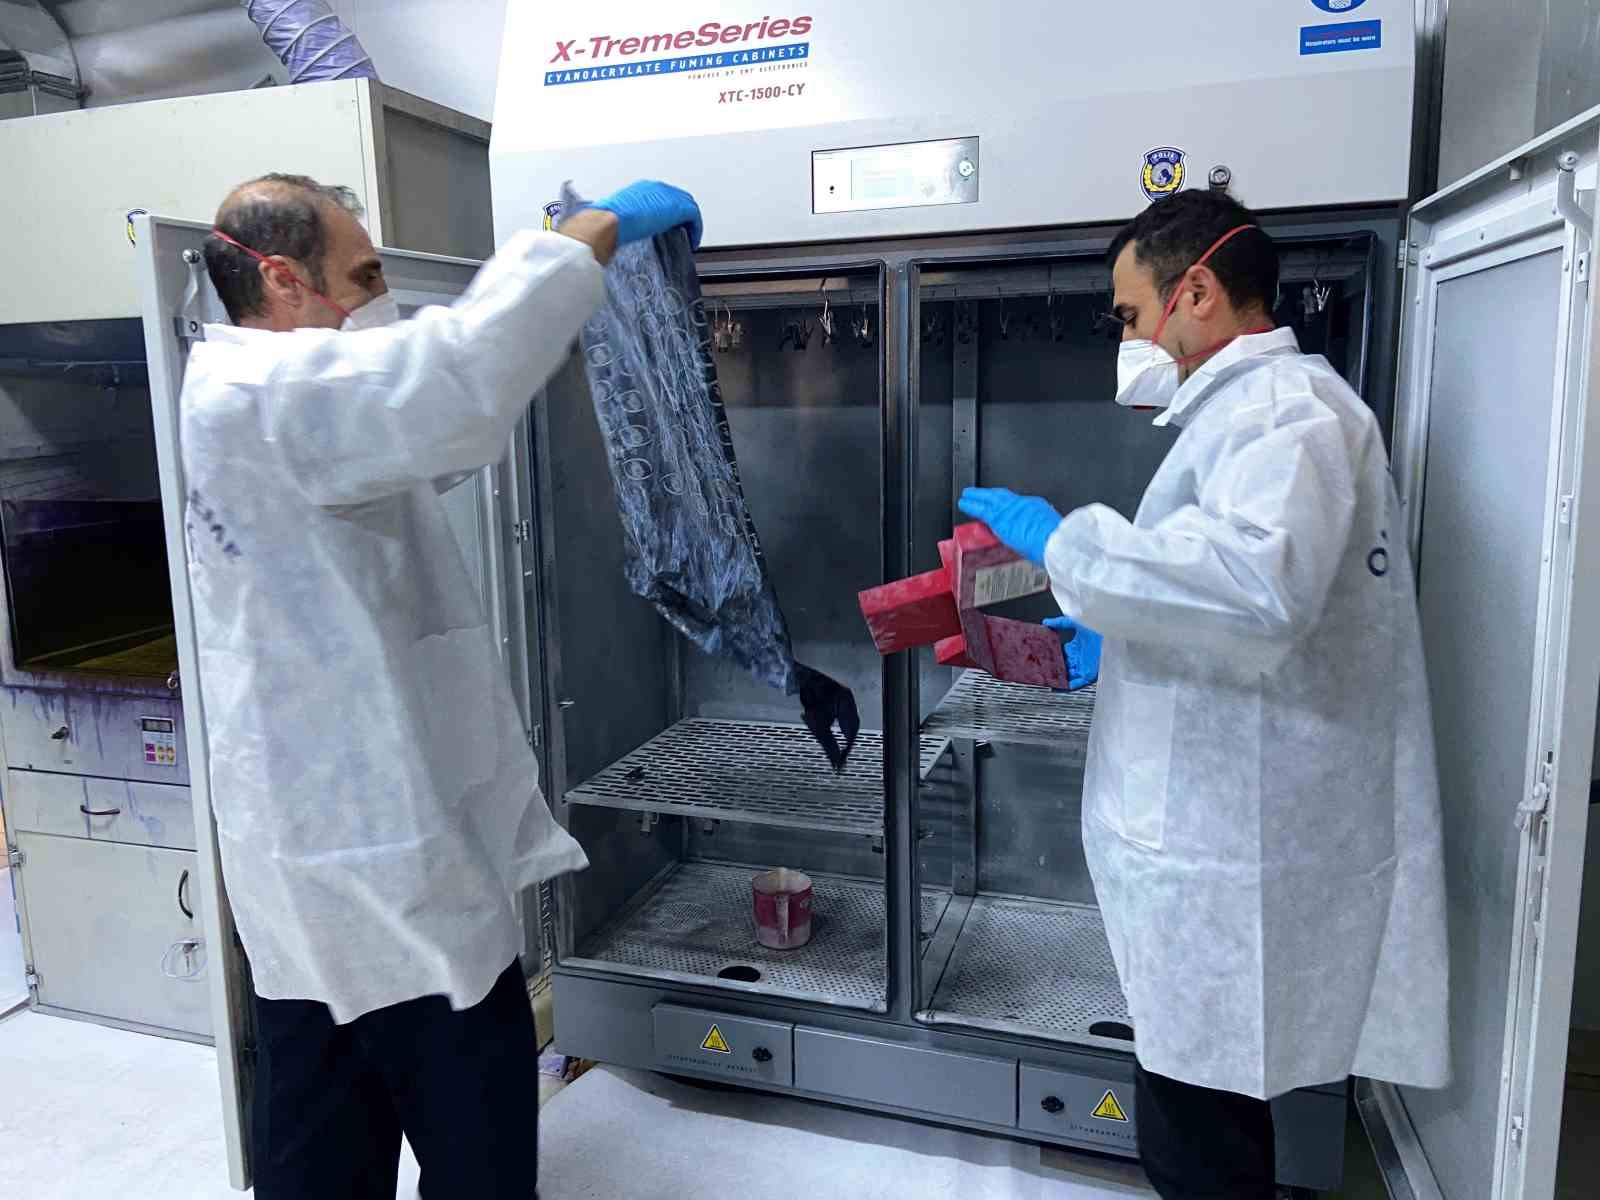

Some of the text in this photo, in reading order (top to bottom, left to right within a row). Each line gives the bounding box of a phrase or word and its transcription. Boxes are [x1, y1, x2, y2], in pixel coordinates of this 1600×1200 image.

[547, 46, 805, 83] CYANOACRYLATE FUMING CABINETS
[718, 82, 806, 104] XTC-1500-CY
